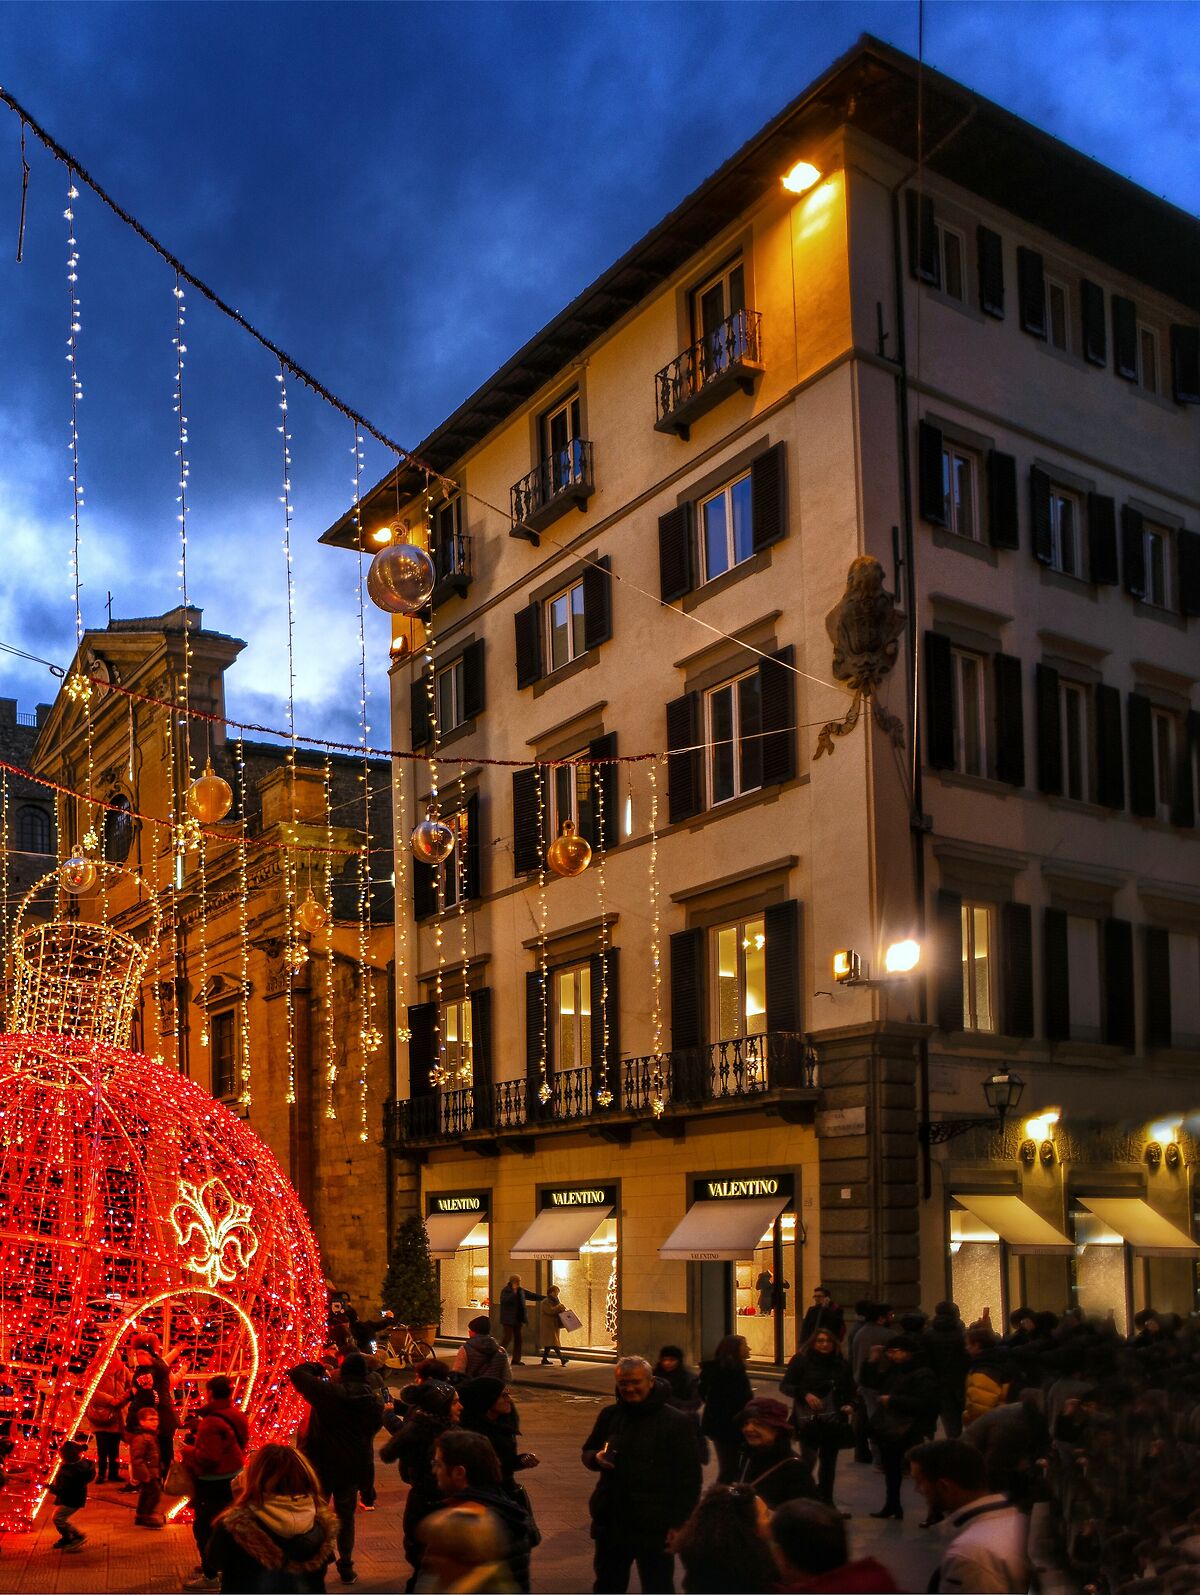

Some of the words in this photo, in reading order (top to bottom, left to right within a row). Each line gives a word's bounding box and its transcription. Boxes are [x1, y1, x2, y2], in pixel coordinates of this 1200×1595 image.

[708, 1179, 778, 1197] VALENTINO
[438, 1198, 480, 1211] VALENTINO
[552, 1190, 605, 1205] VALENTINO
